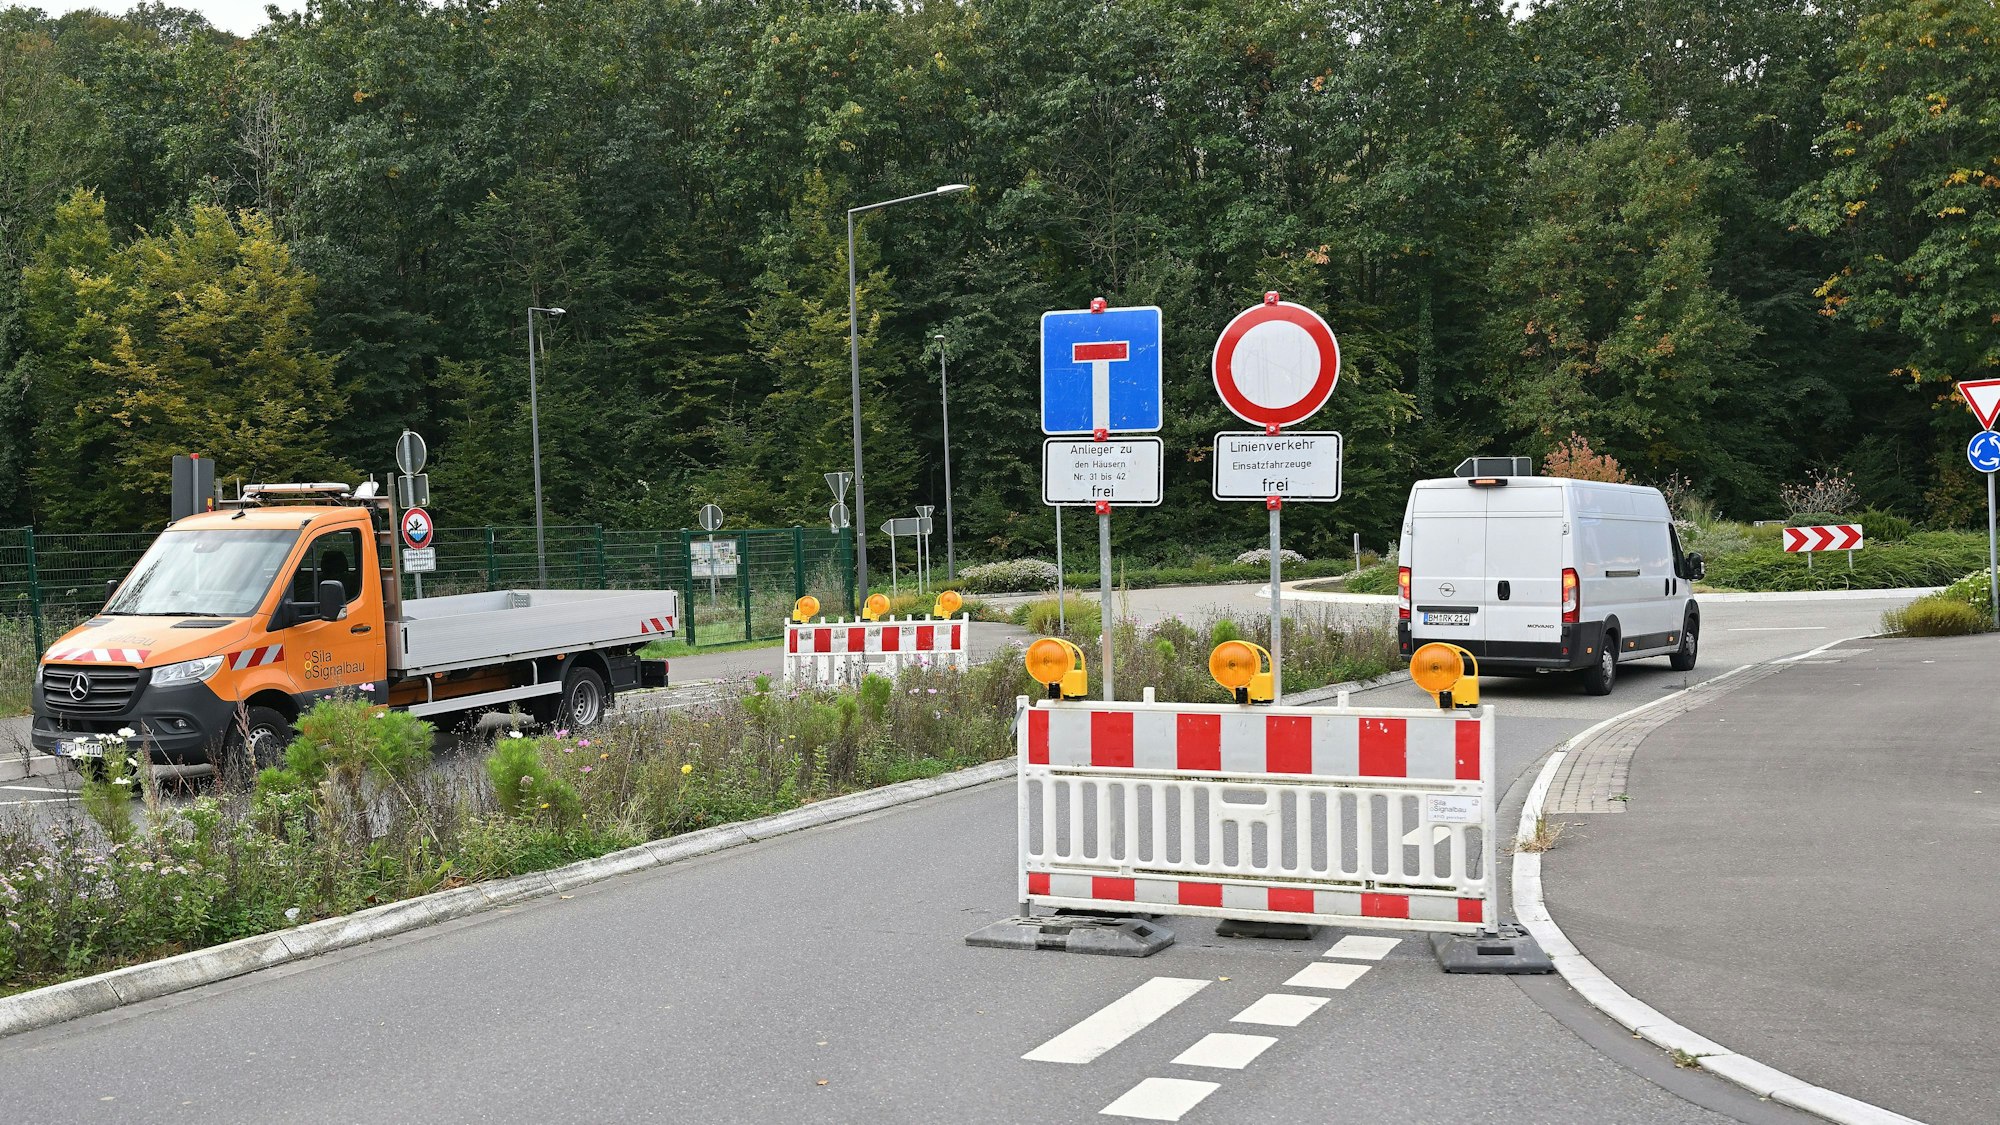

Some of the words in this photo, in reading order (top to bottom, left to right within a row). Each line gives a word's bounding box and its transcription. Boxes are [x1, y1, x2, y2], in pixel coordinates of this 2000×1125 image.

[1070, 445, 1115, 457] Anlieger
[1120, 446, 1133, 454] zu
[1230, 439, 1316, 453] Linienverkehr
[1074, 461, 1089, 469] den
[1092, 460, 1126, 468] Häusern
[1232, 460, 1312, 471] Einsatzfahrzeuge
[1073, 473, 1086, 481] Nr.
[1089, 473, 1098, 481] 31
[1100, 473, 1112, 481] bis
[1116, 473, 1126, 481] 42
[1262, 478, 1289, 492] frei
[1091, 485, 1115, 498] frei
[1454, 614, 1469, 622] 214
[311, 650, 332, 664] Sila
[312, 661, 365, 681] Signalbau
